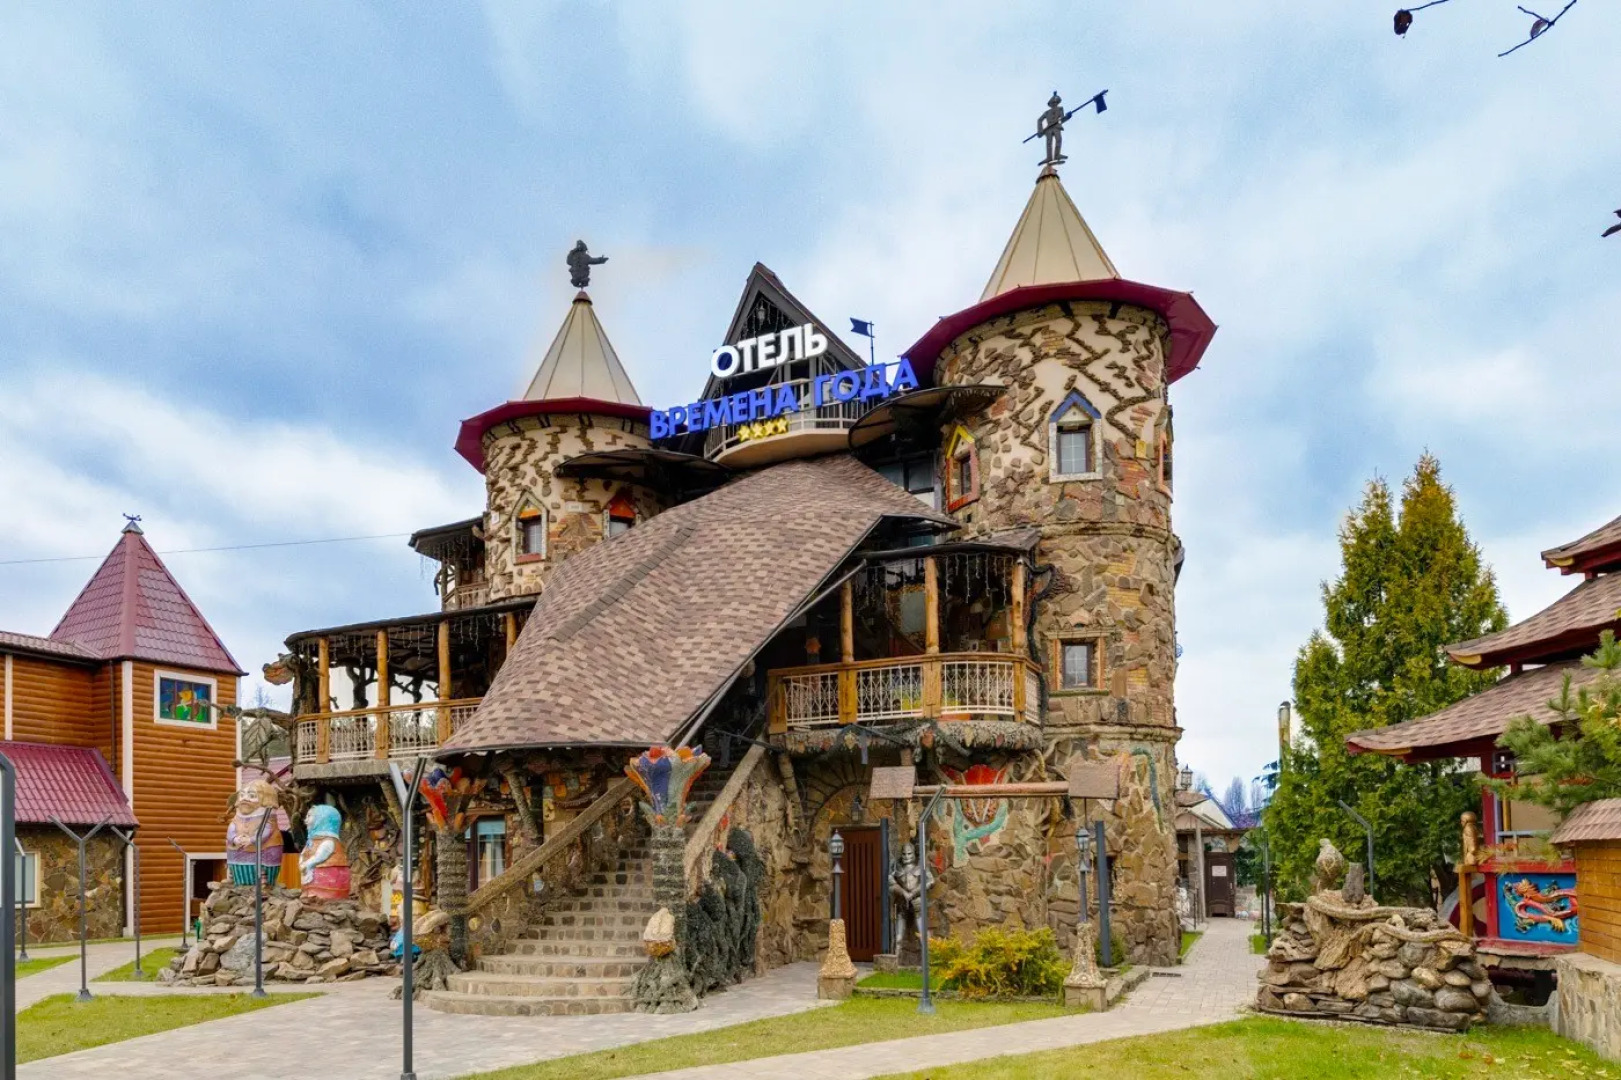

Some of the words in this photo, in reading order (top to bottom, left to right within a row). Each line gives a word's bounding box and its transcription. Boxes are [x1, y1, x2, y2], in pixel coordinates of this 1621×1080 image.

[711, 323, 828, 378] ОТЕЛЬ
[650, 384, 799, 439] ВРЕМЕНА
[814, 357, 919, 406] ГОДА
